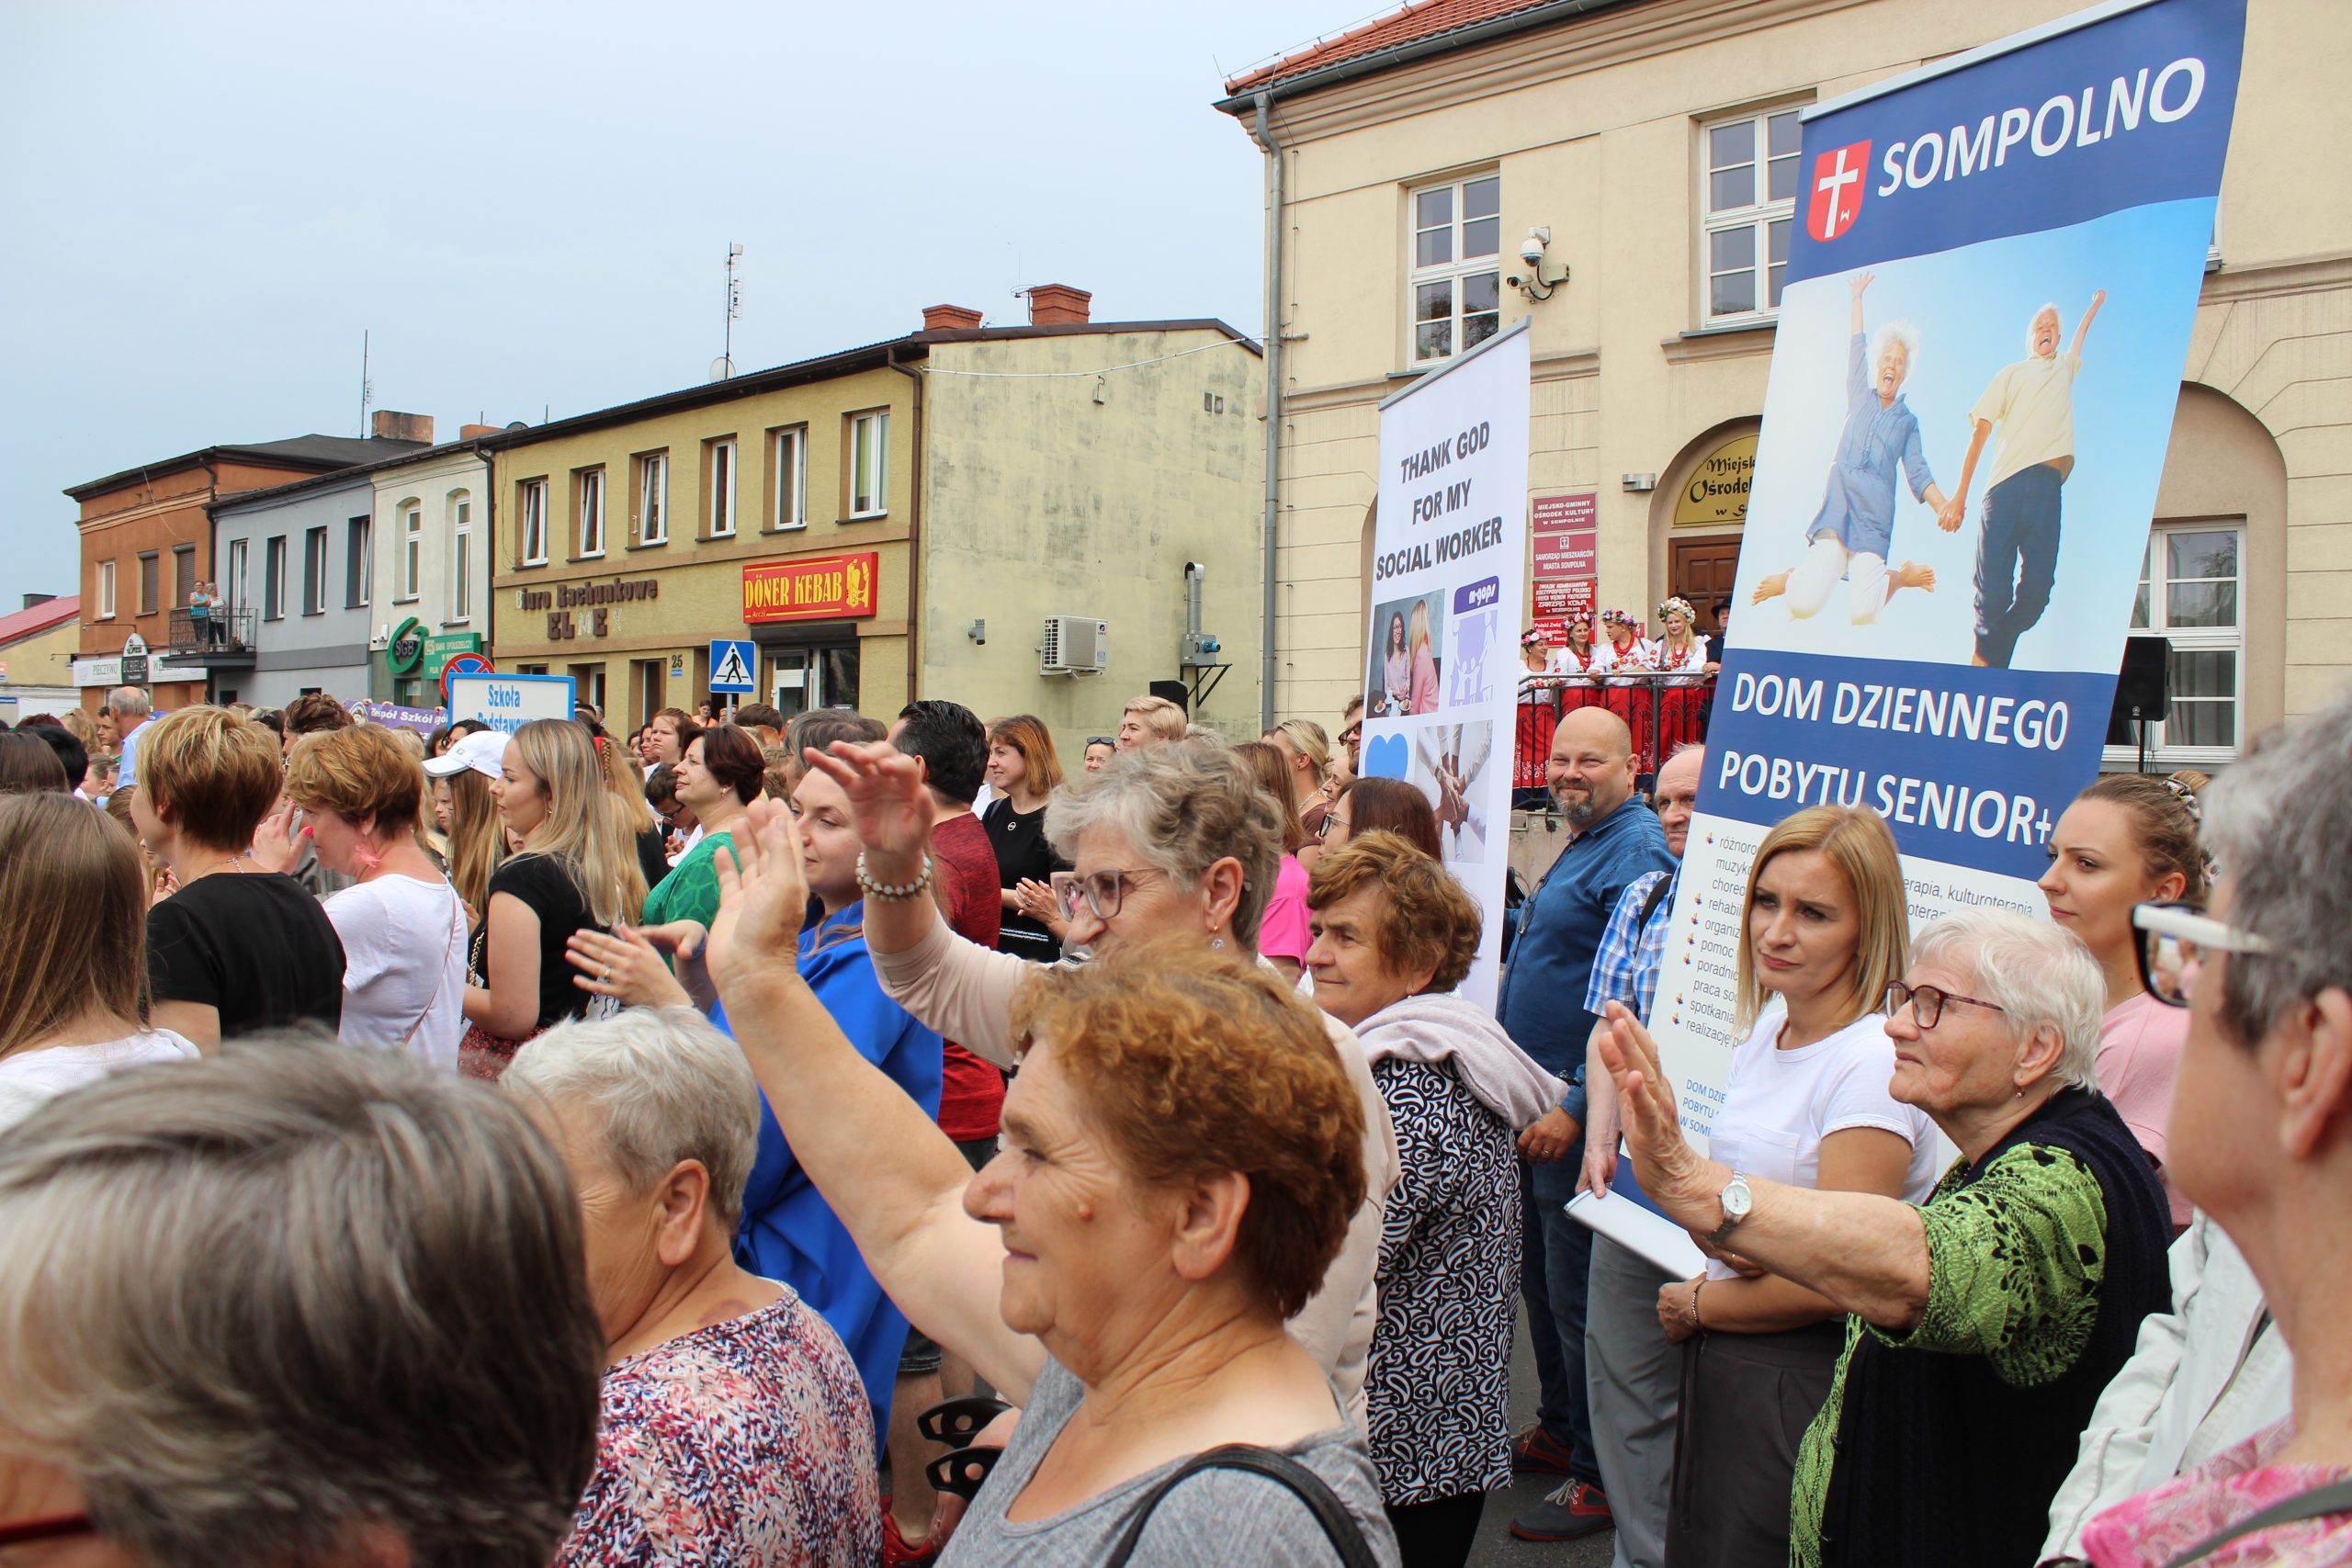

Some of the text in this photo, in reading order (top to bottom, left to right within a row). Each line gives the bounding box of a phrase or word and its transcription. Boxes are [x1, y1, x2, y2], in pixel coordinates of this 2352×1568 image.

[1877, 57, 2207, 198] SOMPOLNO
[1401, 421, 1490, 484] THANK GOD
[1412, 478, 1472, 525] FOR MY
[1537, 500, 1590, 511] MIEJSKO-GMINNY
[1533, 508, 1594, 519] OŚRODEK KULTURY
[1376, 515, 1502, 581] SOCIAL WORKER
[1535, 549, 1594, 561] SAMORZĄD MIESZKAŃCÓW
[1561, 560, 1587, 569] SOMPOLNA
[516, 578, 659, 610] Biuro Rachunkowe
[744, 571, 842, 609] DÖNER KEBAB
[395, 641, 414, 656] SGB
[672, 654, 683, 668] 25
[488, 683, 521, 707] Szkoła
[370, 707, 398, 720] Zespół
[400, 711, 433, 724] Szkół
[1731, 672, 2069, 751] DOM DZIENNEGO
[1719, 750, 2052, 846] POBYTU SENIOR+
[1719, 836, 1758, 855] różnoro
[1712, 877, 1746, 897] choreo
[1704, 919, 1741, 939] organiz
[1701, 940, 1735, 958] pomoc
[1692, 979, 1721, 998] praca
[1690, 999, 1736, 1024] spotkania
[1686, 1020, 1731, 1047] realizację
[1686, 1078, 1707, 1096] DOM
[1682, 1097, 1714, 1119] POBYTU
[1679, 1114, 1689, 1127] W
